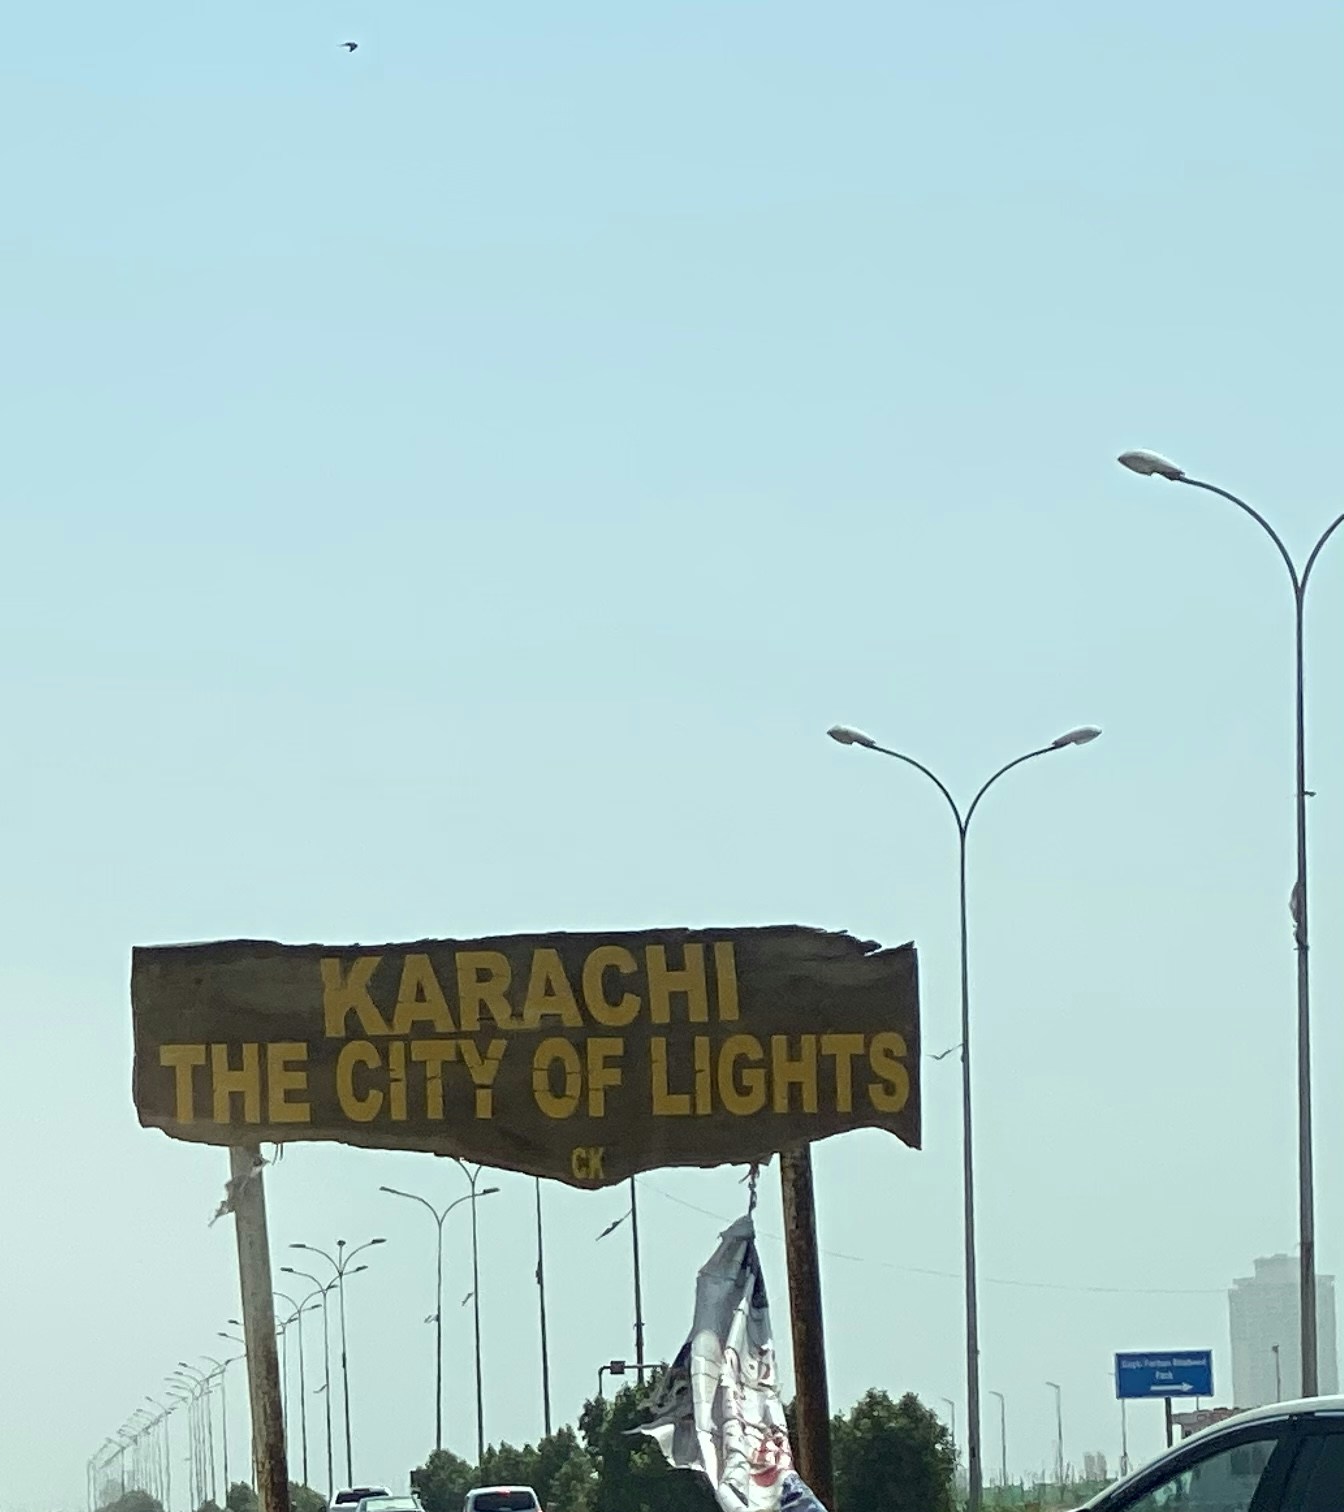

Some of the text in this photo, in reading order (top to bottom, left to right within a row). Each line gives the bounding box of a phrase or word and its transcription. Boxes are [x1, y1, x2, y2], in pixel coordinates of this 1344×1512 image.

[319, 940, 740, 1038] KARACHI
[160, 1031, 910, 1124] THE CITY OF LIGHTS
